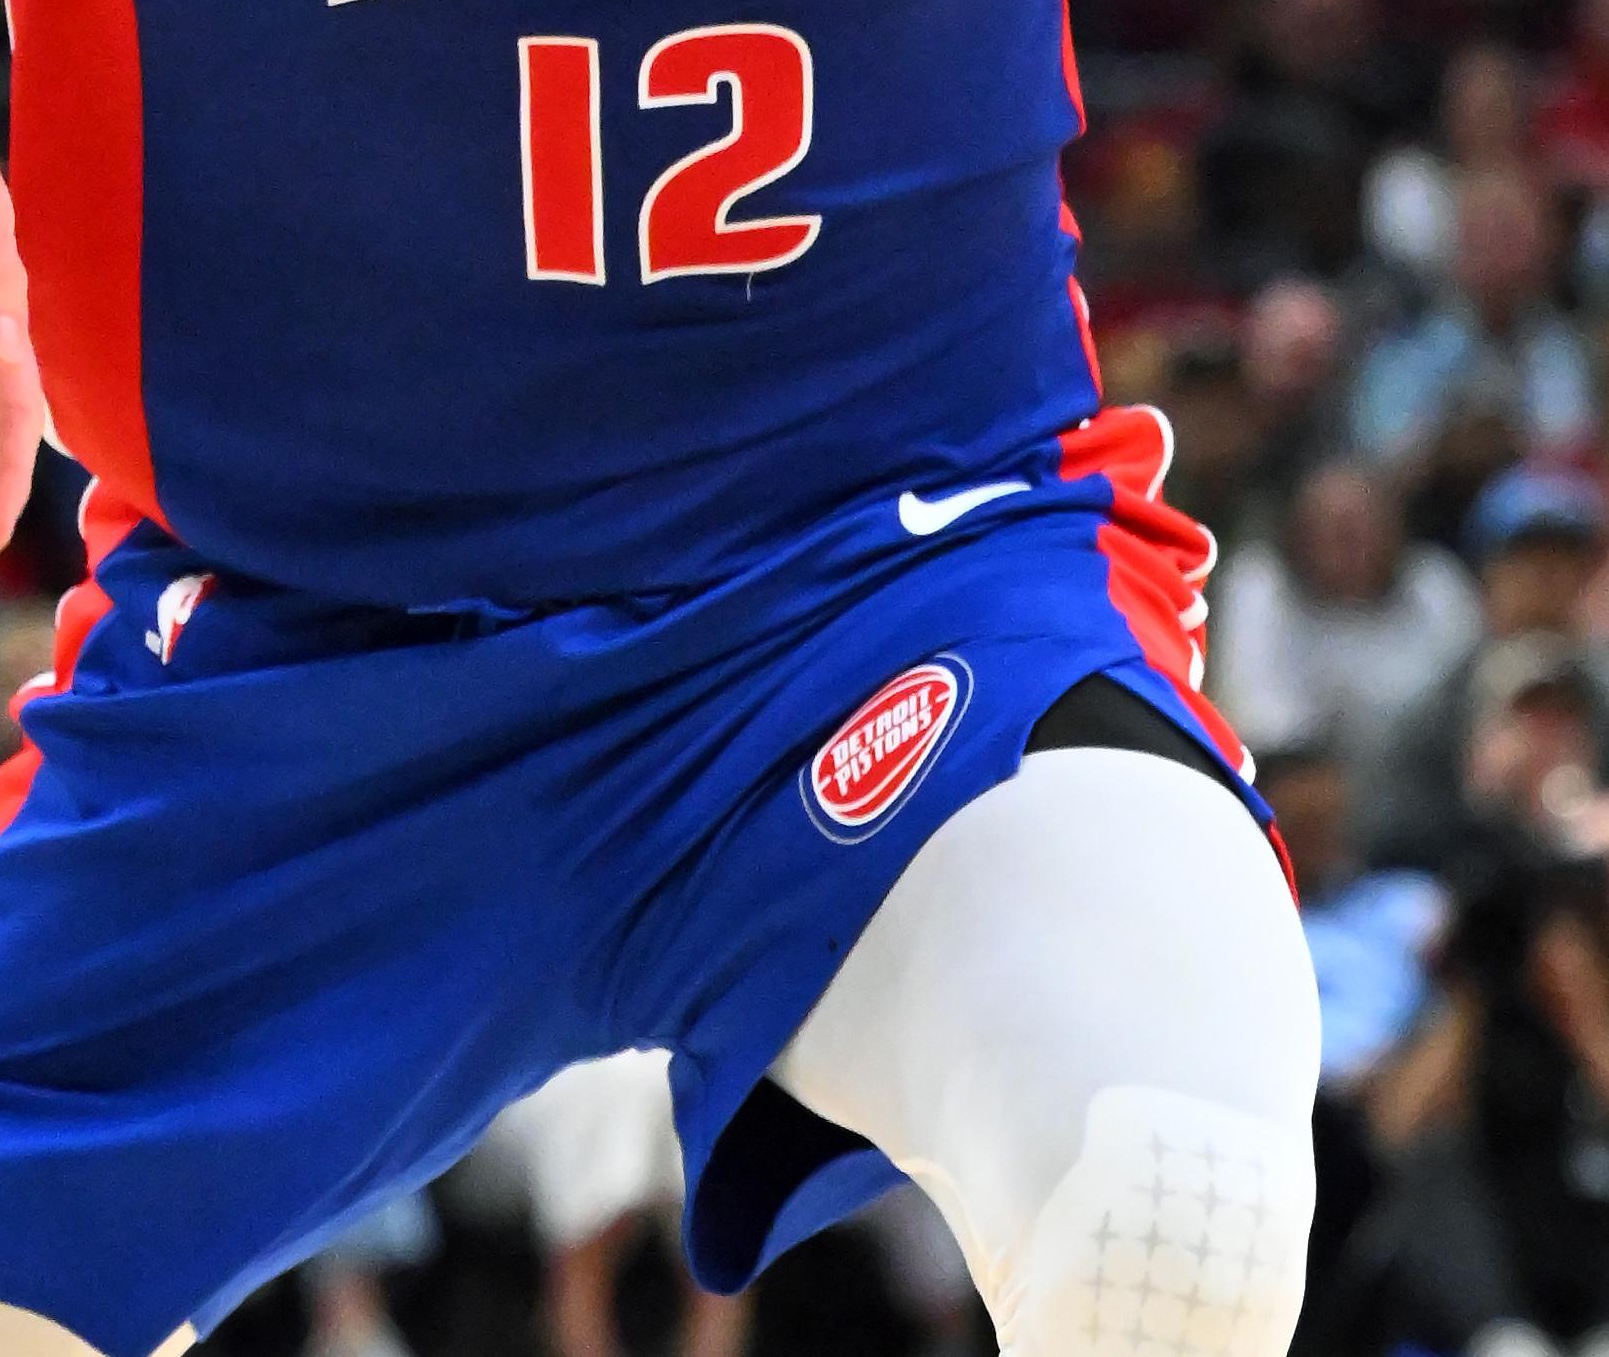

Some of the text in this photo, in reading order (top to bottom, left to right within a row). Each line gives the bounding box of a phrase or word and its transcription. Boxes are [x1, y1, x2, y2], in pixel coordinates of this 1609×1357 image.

[517, 24, 822, 287] 12
[832, 686, 932, 769] DETROIT
[835, 706, 933, 797] PISTONS
